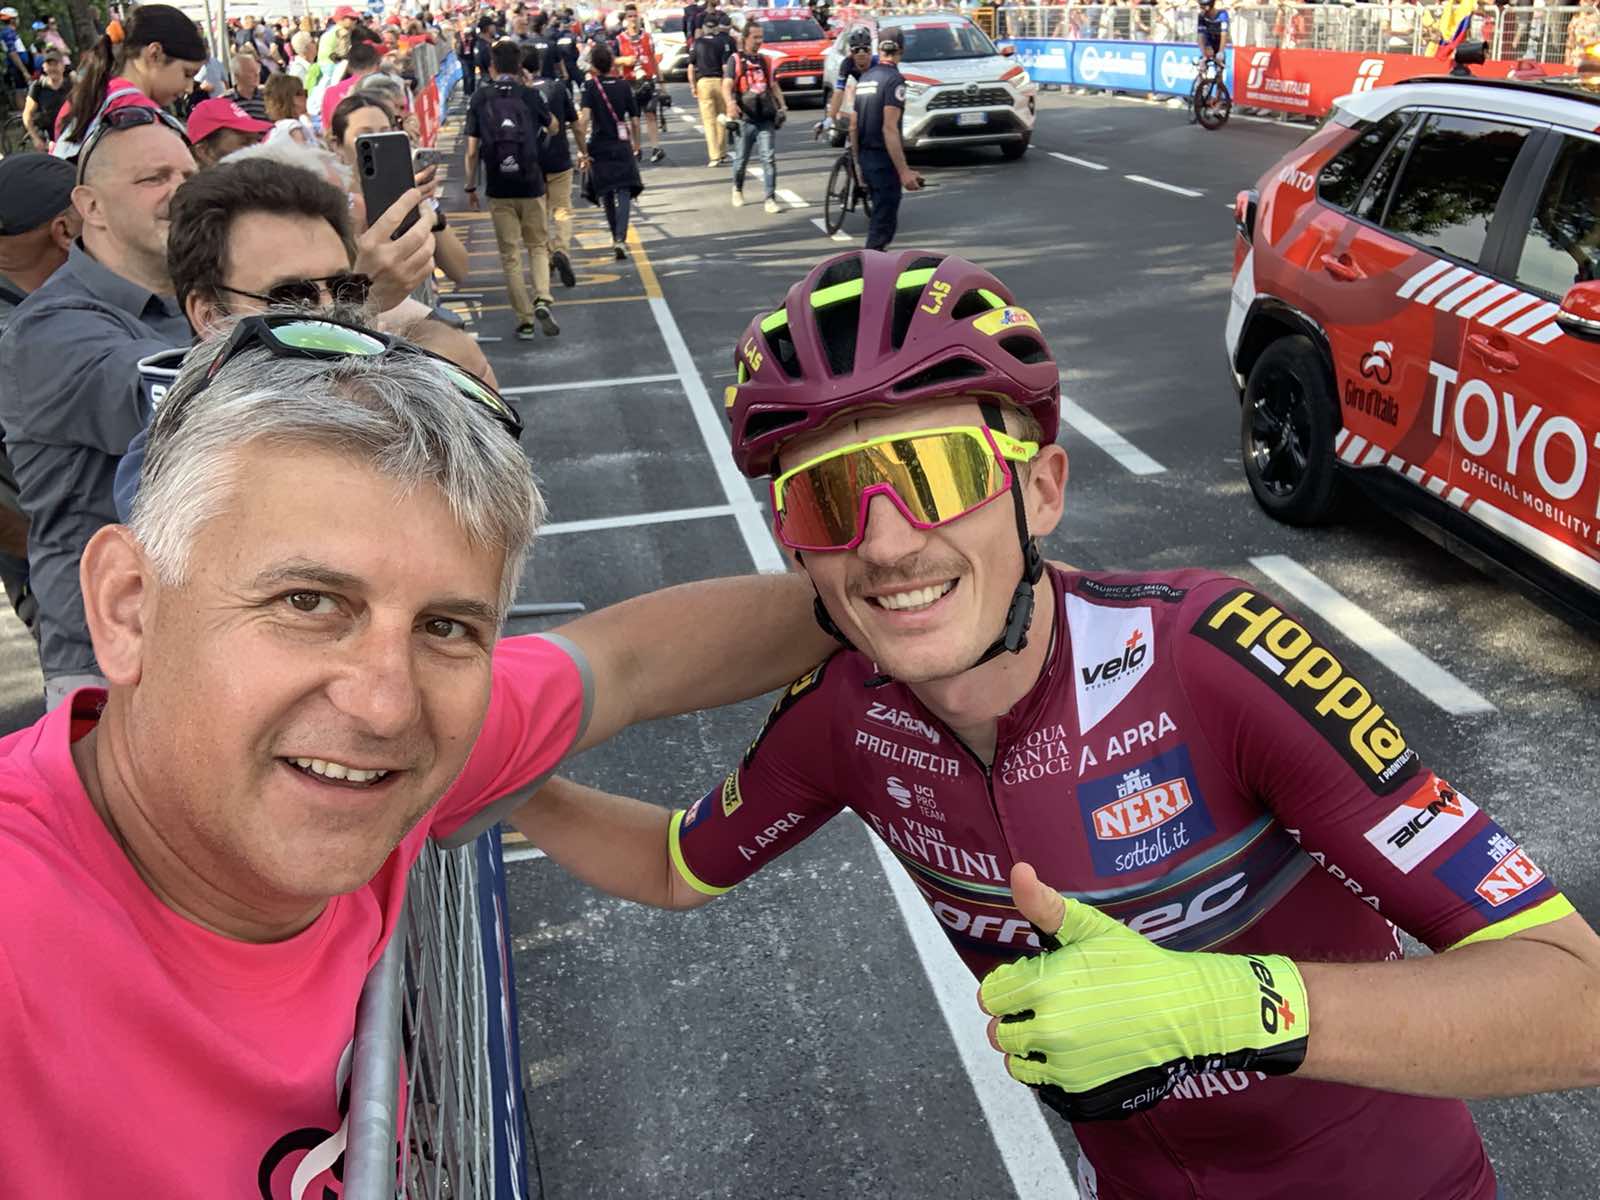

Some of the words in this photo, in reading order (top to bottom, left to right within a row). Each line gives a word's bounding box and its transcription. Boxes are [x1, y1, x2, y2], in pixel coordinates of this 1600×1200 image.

[921, 280, 952, 314] LAS
[744, 336, 763, 373] LAS
[1345, 379, 1365, 412] Giro
[1428, 360, 1600, 520] TOYO
[1461, 458, 1519, 500] OFFICIAL
[1522, 491, 1591, 539] MOBILITY
[1081, 643, 1147, 686] velo
[855, 729, 959, 777] PAGLIACCIA
[1002, 740, 1070, 772] SANTA
[1106, 711, 1177, 761] APRA
[1002, 755, 1072, 785] CROCE
[913, 783, 934, 799] UCI
[916, 794, 937, 810] PRO
[1097, 782, 1189, 837] NERI
[754, 811, 805, 848] APRA
[866, 811, 1006, 882] FANTINI
[902, 816, 946, 843] VINI
[1115, 822, 1190, 871] sottoli.it
[1479, 849, 1544, 903] NE
